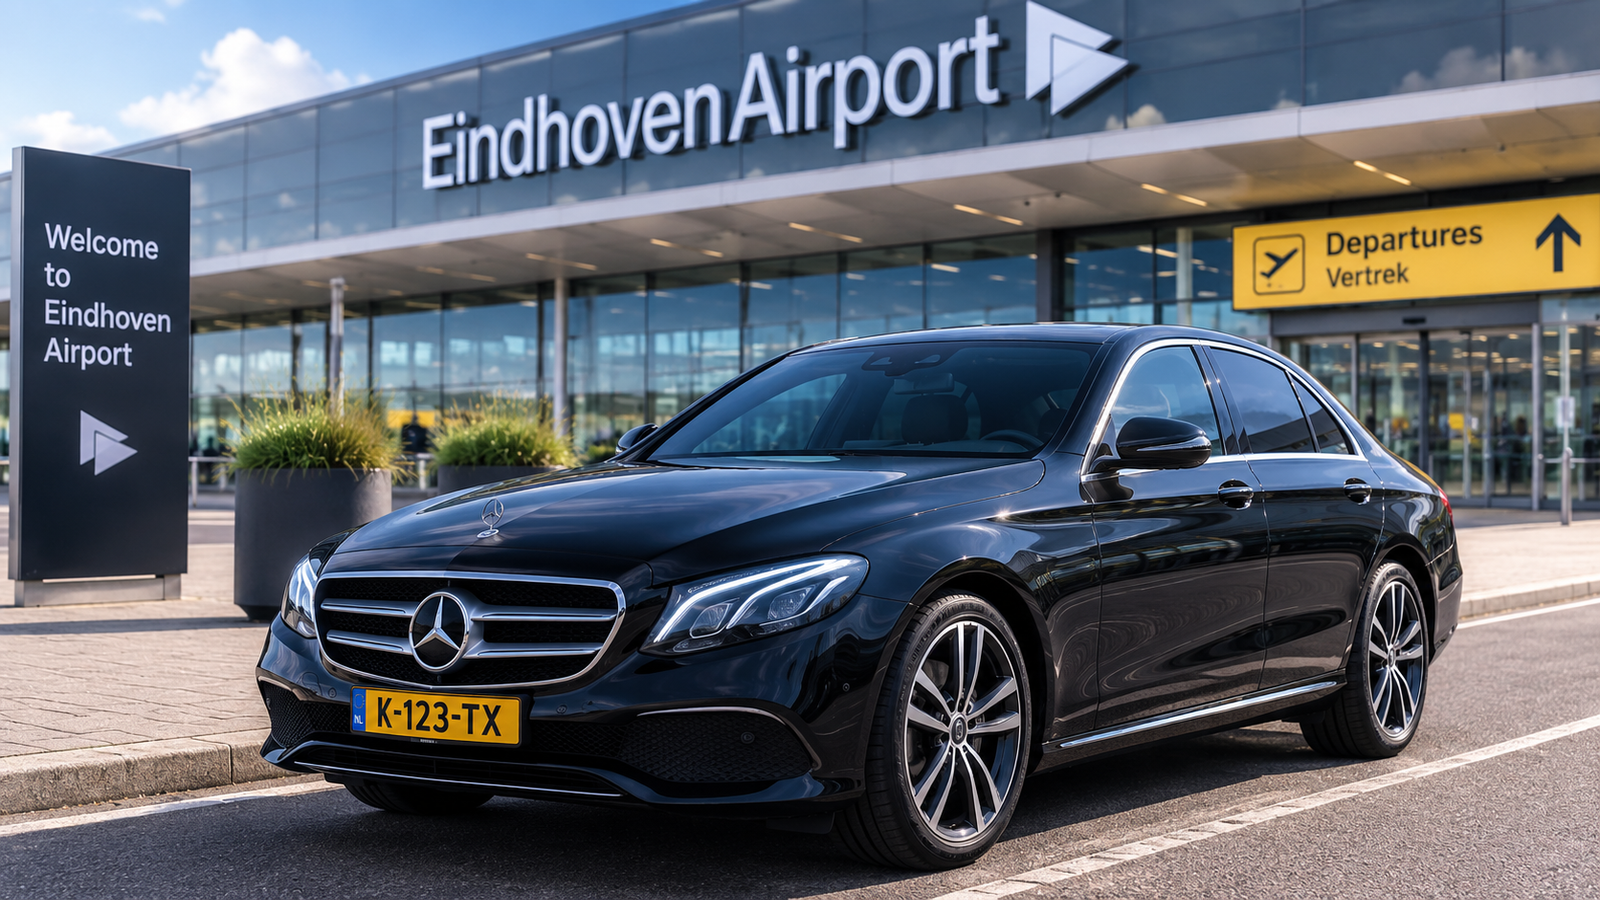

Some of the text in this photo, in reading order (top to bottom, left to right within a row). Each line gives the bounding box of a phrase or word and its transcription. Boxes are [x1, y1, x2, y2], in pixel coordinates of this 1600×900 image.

[44, 222, 159, 260] Welcome
[1326, 225, 1483, 260] Departures
[44, 262, 71, 288] to
[1326, 262, 1409, 288] Vertrek
[44, 298, 171, 333] Eindhoven
[43, 337, 133, 371] Airport
[354, 714, 364, 725] NL
[377, 696, 502, 737] K-123-TX
